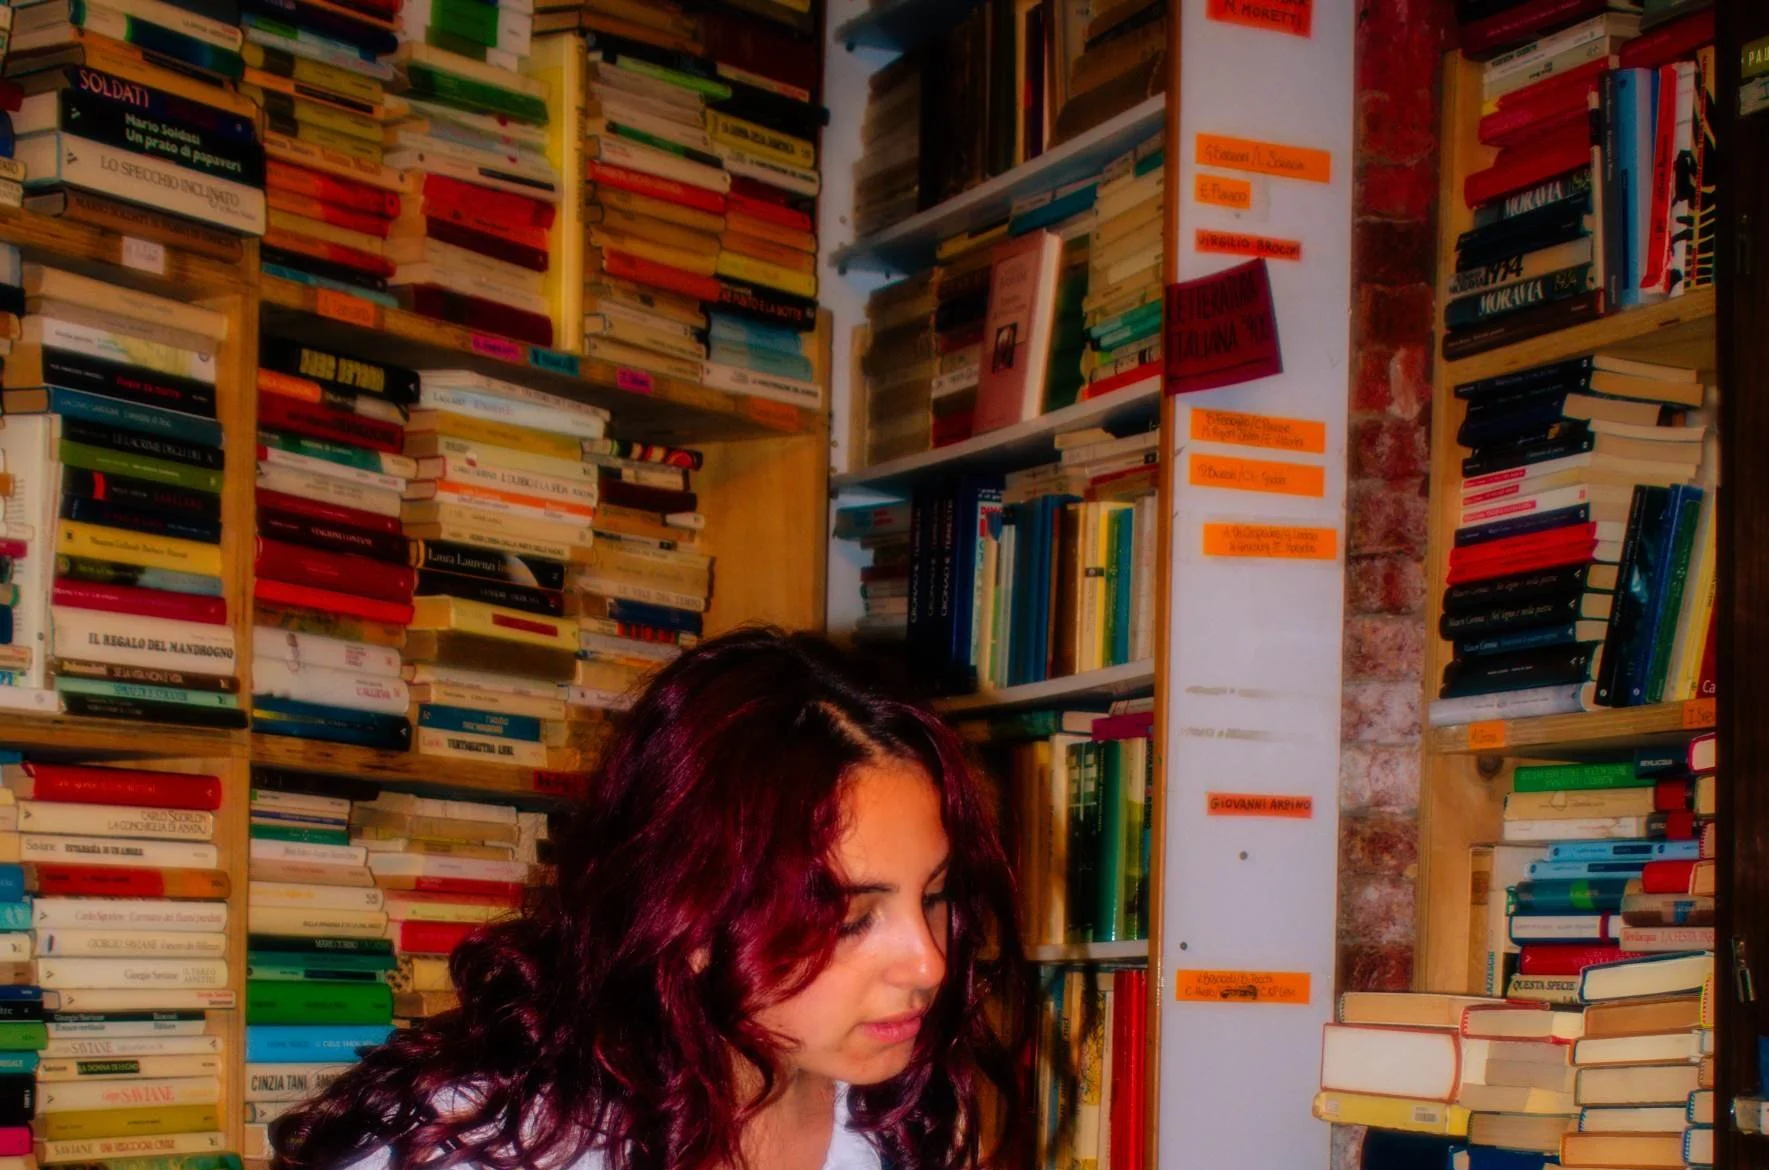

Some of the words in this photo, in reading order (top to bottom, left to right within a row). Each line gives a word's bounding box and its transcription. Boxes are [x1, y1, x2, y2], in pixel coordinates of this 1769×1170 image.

[80, 69, 150, 108] SOLDATI
[124, 112, 159, 133] Mario
[161, 121, 201, 145] Soldati
[126, 128, 144, 144] Un
[145, 136, 179, 154] prato
[180, 144, 191, 157] di
[193, 149, 242, 173] papaveri
[100, 155, 119, 171] LO
[121, 162, 179, 190] SPECCHIO
[1478, 279, 1545, 317] MORAVIA
[89, 632, 101, 645] IL
[103, 633, 145, 650] REGALO
[148, 637, 166, 651] DEL
[169, 641, 234, 659] MANDROGNO
[1210, 797, 1266, 811] GIOVANNI
[1269, 798, 1312, 812] ARPINO
[1513, 980, 1545, 991] QUESTA
[1546, 980, 1576, 991] SPECIE
[252, 1074, 283, 1092] CINZIA
[287, 1074, 308, 1092] TANI
